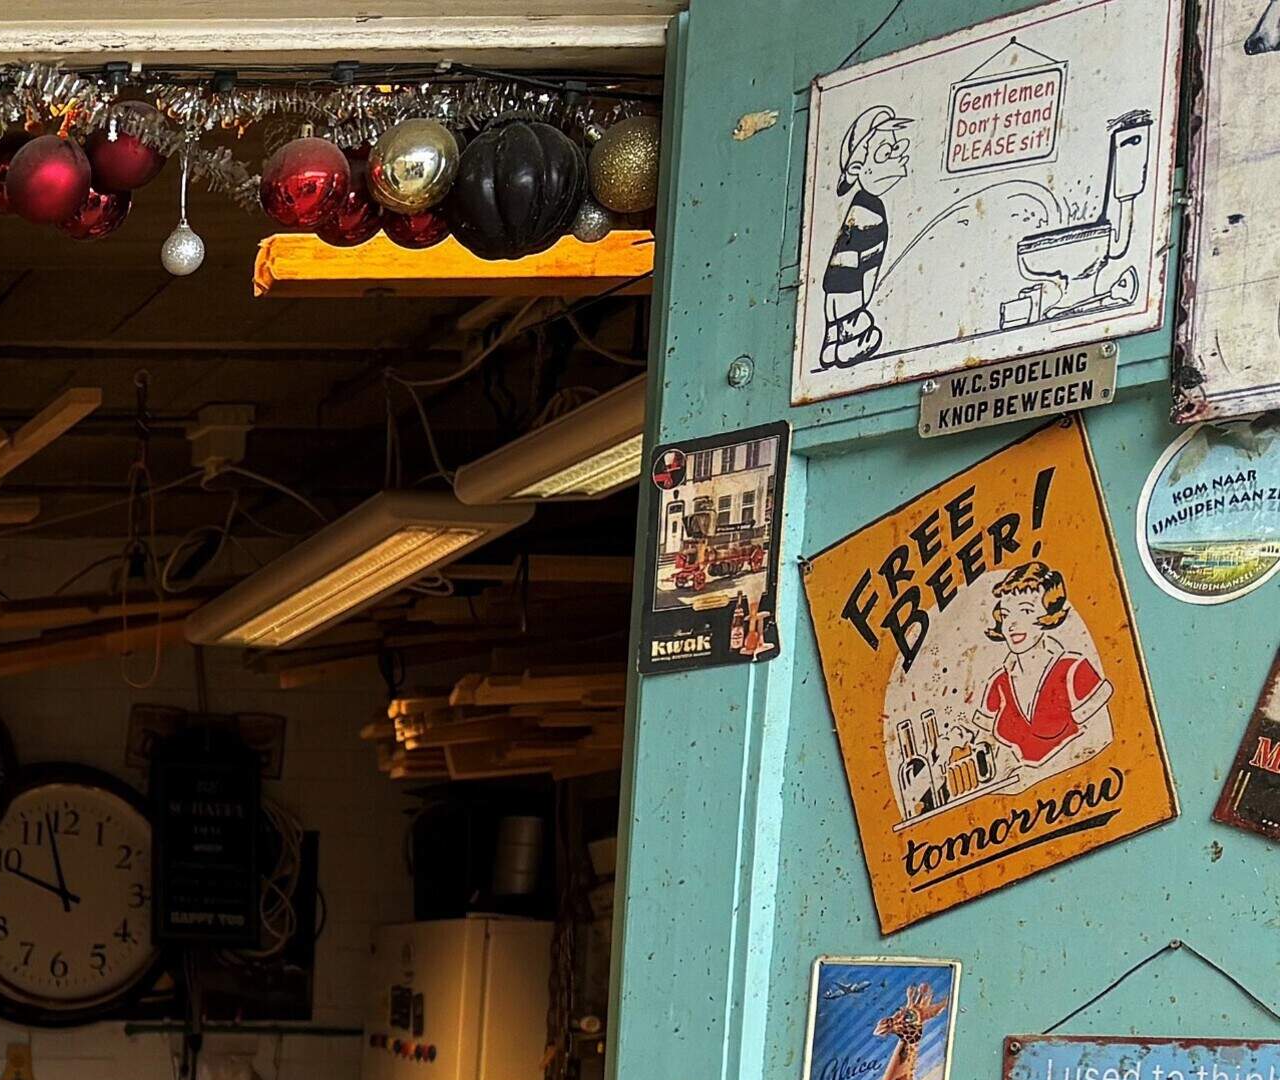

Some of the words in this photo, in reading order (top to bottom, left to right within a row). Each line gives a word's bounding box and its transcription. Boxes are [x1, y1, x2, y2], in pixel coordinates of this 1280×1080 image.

[959, 80, 1055, 113] Gentlemen
[956, 113, 1000, 138] Don't
[1003, 100, 1053, 128] stand
[952, 133, 1017, 162] PLEASE
[938, 399, 988, 429] KNOP
[992, 380, 1095, 418] BEWEGEN
[1172, 482, 1208, 504] KOM
[1212, 469, 1257, 489] NAAR
[1152, 496, 1225, 535] IJMUIDEN
[1229, 489, 1263, 504] AAN
[840, 485, 976, 651] FREE
[880, 466, 1056, 673] BEER!
[23, 820, 42, 845] 11
[54, 810, 80, 836] 12
[97, 821, 103, 846] 1
[902, 766, 1127, 880] tomorrow
[115, 845, 131, 869] 2
[128, 883, 145, 908] 3
[113, 918, 131, 943] 4
[20, 942, 35, 966] 7
[50, 950, 68, 978] 6
[90, 944, 106, 970] 5
